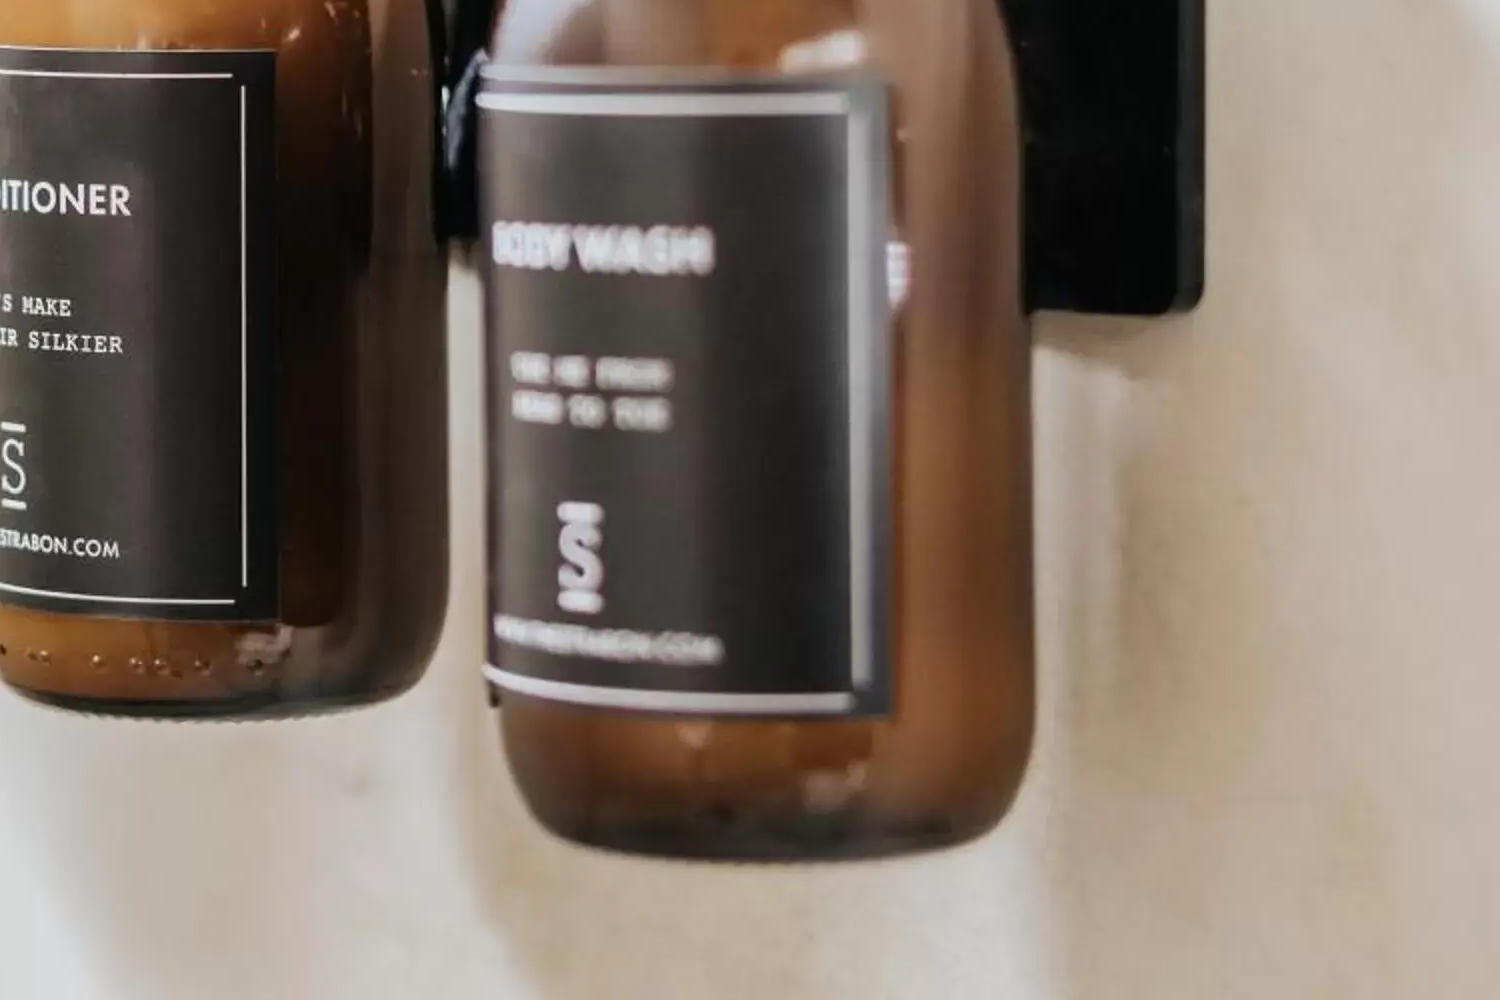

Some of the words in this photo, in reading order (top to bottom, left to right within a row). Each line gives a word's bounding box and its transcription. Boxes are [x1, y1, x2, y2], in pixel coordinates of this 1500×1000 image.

[22, 296, 71, 317] MAKE
[28, 331, 123, 353] SILKIER
[1, 438, 27, 495] S
